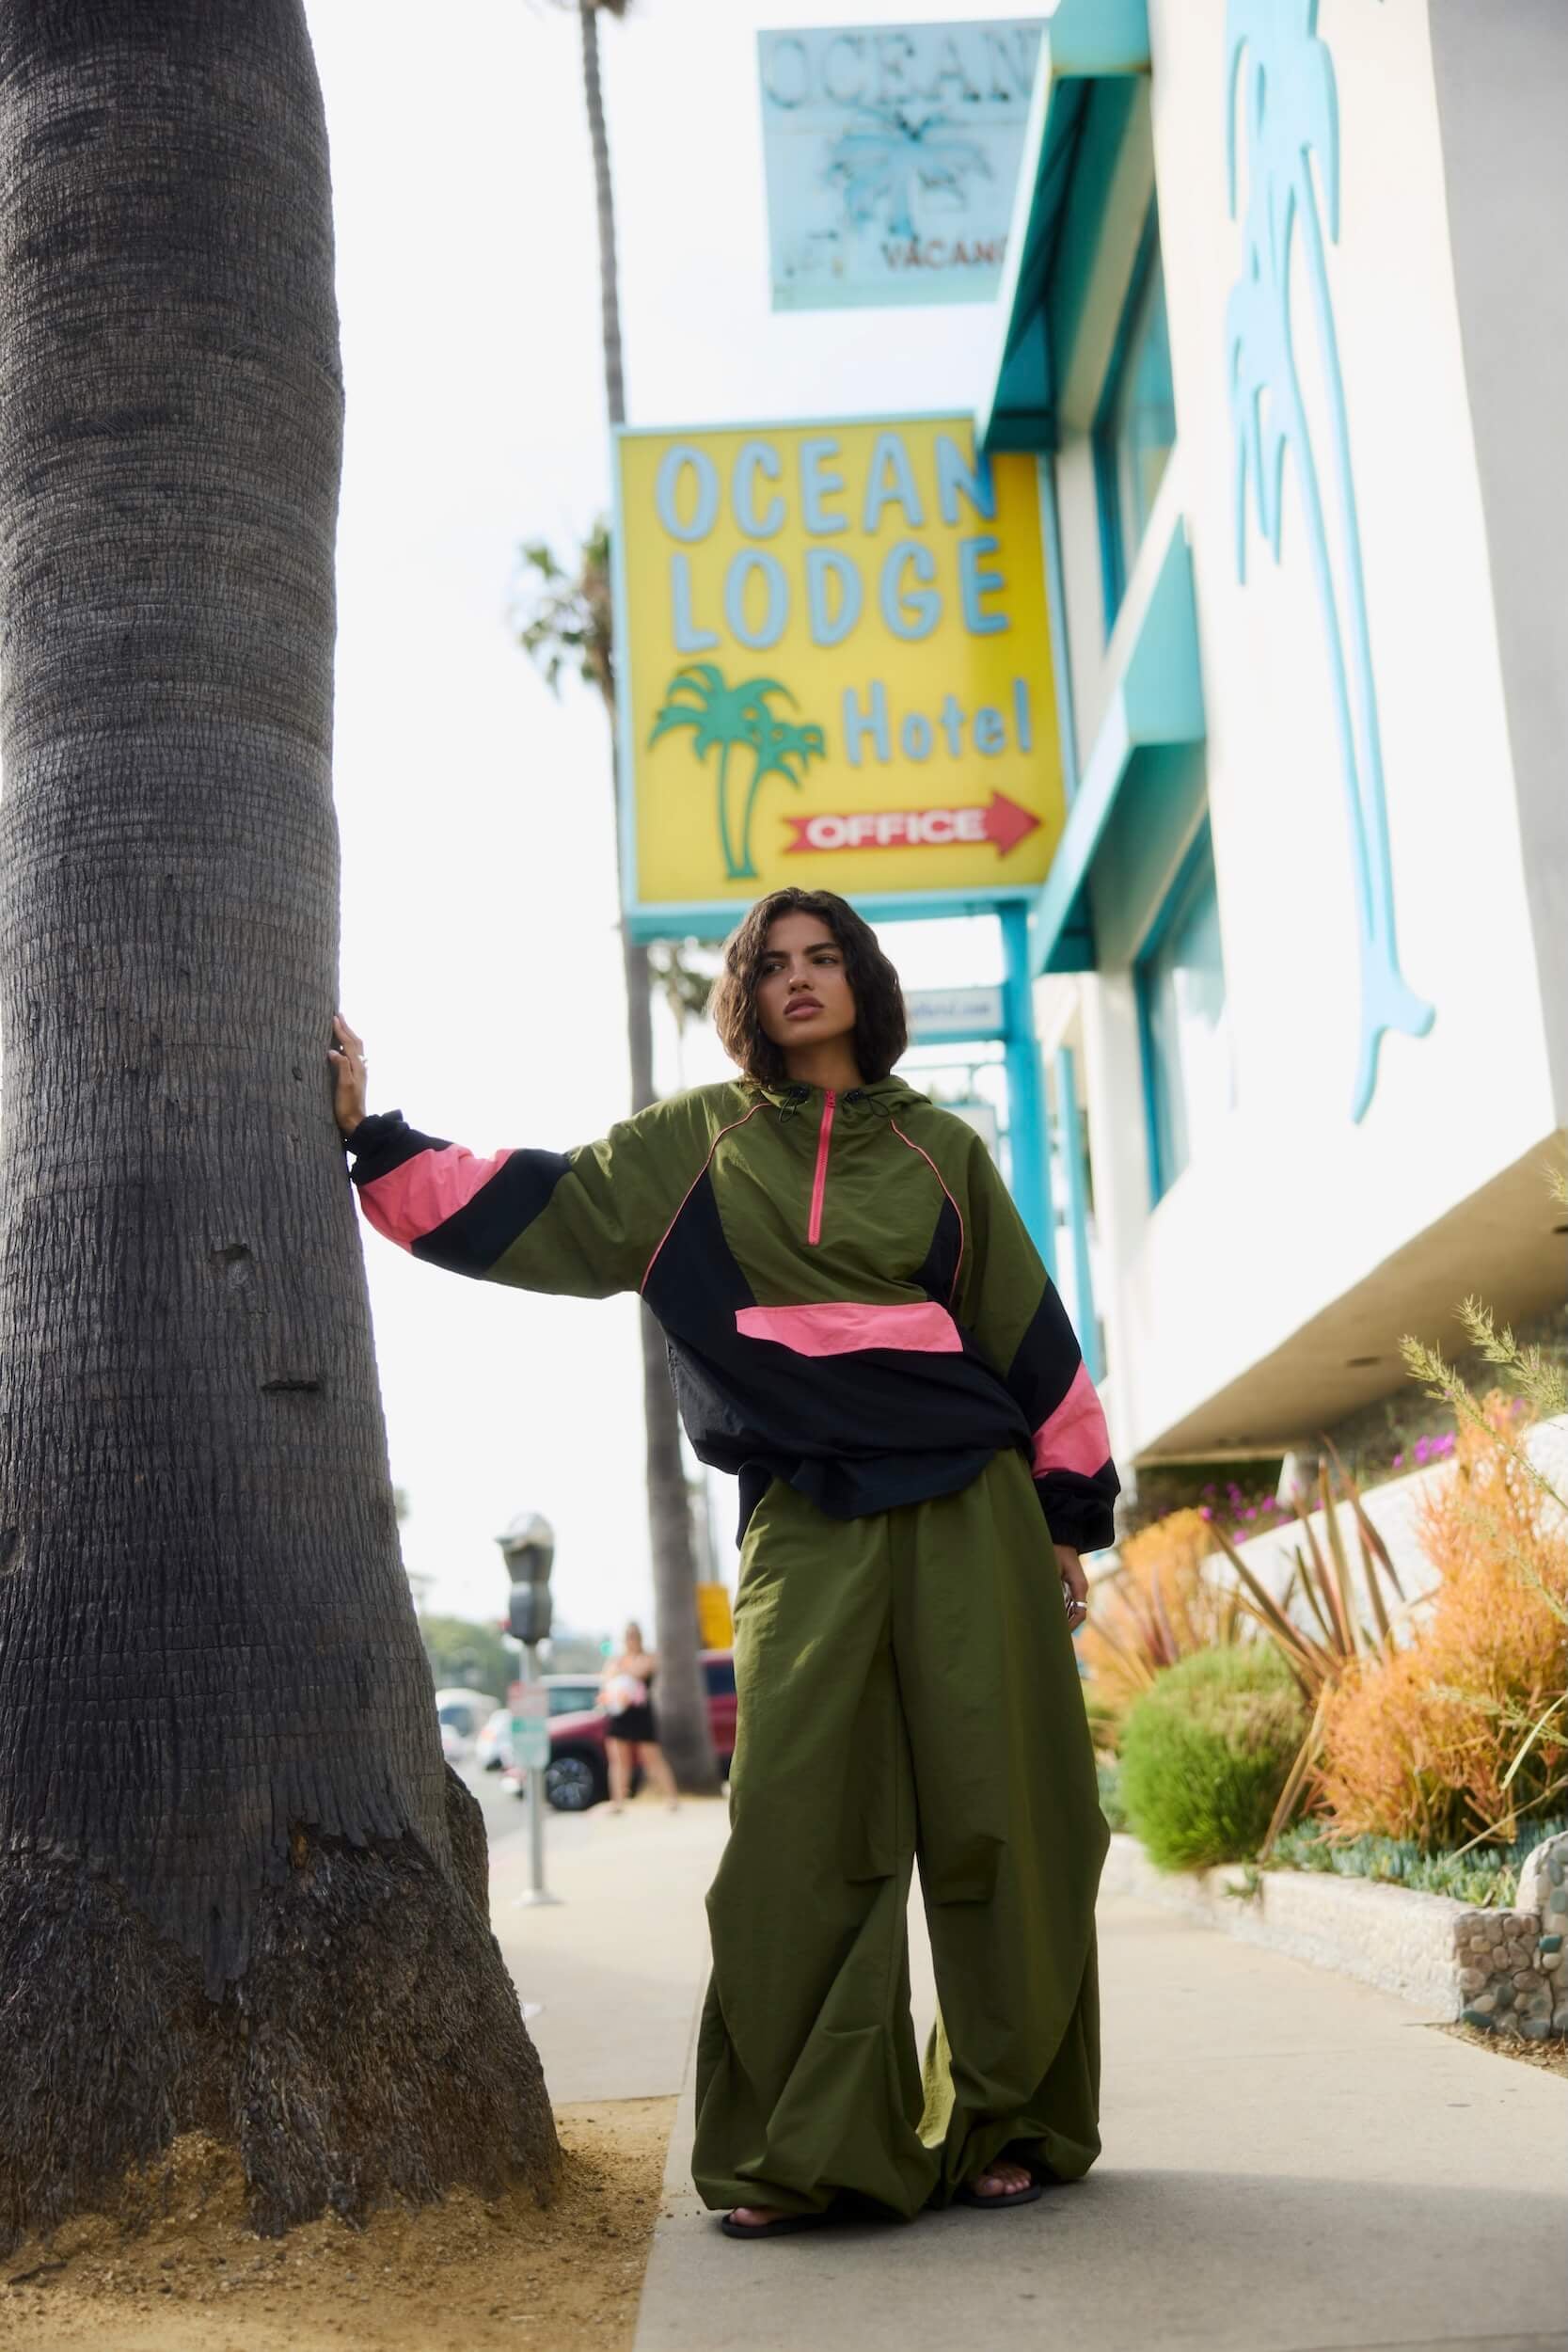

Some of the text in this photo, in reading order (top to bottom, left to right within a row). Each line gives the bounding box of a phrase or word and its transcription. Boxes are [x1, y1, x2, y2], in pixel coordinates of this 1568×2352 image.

[763, 26, 1041, 110] OCEAN
[880, 235, 1006, 270] VACAN
[656, 432, 998, 543] OCEAN
[669, 535, 1010, 654] LODGE
[842, 678, 1033, 767] Hotel
[806, 807, 988, 849] OFFICE
